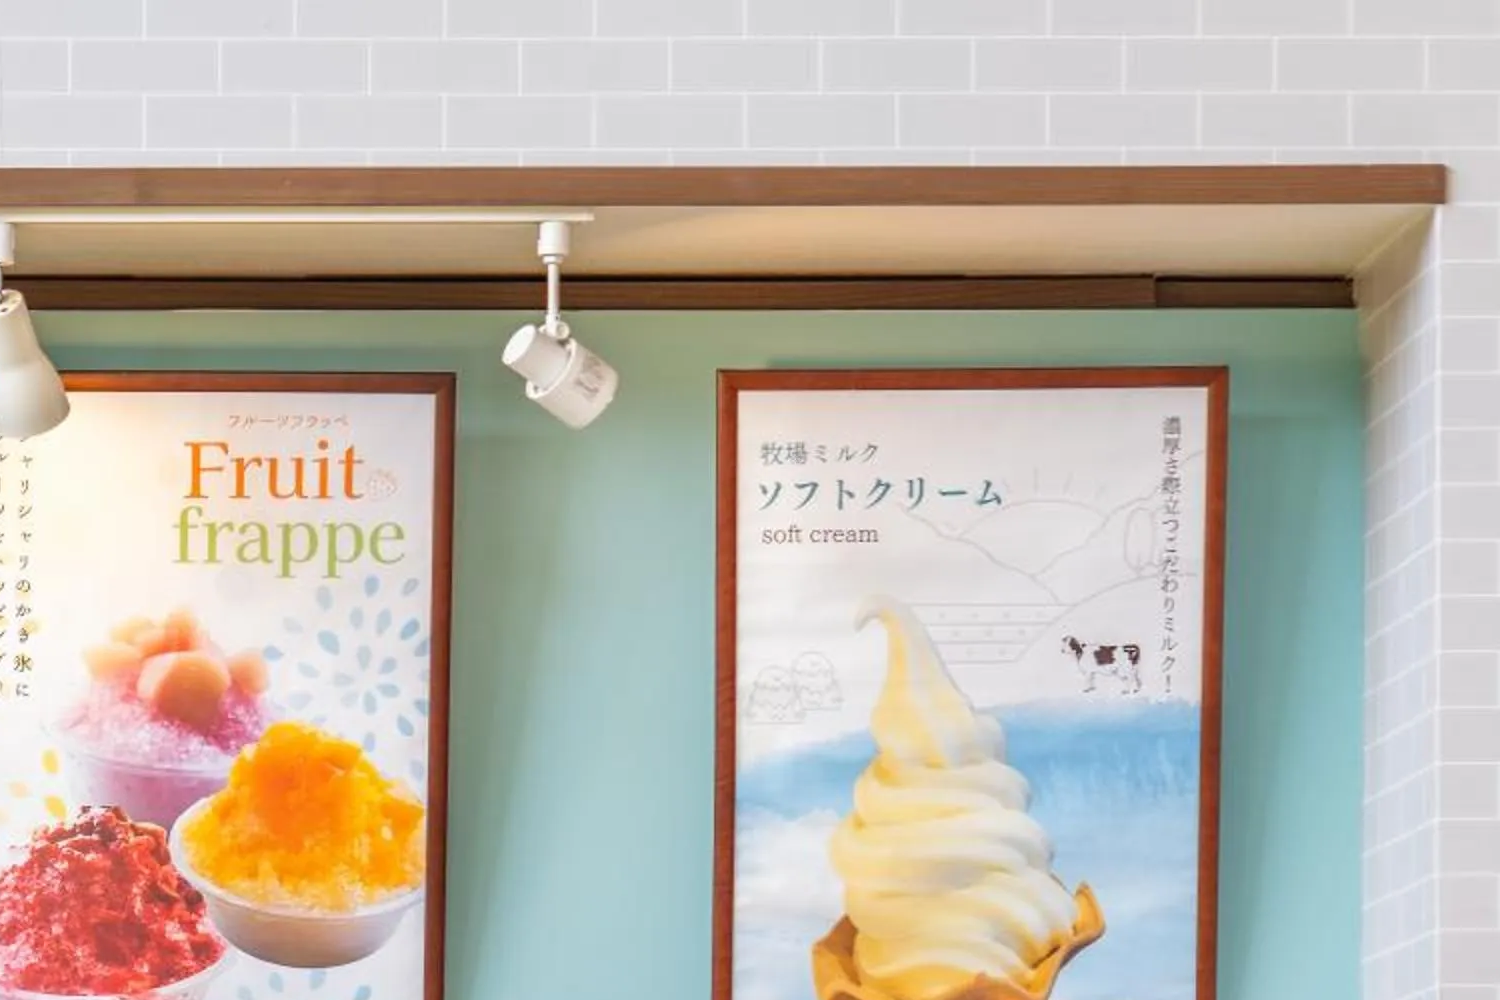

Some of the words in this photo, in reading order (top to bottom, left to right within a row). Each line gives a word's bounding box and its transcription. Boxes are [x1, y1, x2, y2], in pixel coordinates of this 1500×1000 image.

[182, 439, 365, 500] Fruit
[759, 441, 880, 467] 牧場ミルク
[757, 476, 1004, 511] ソフトクリーム
[171, 505, 406, 580] frappe
[761, 525, 803, 544] soft
[810, 526, 880, 544] cream
[12, 437, 35, 698] ャリシャリのかき氷に
